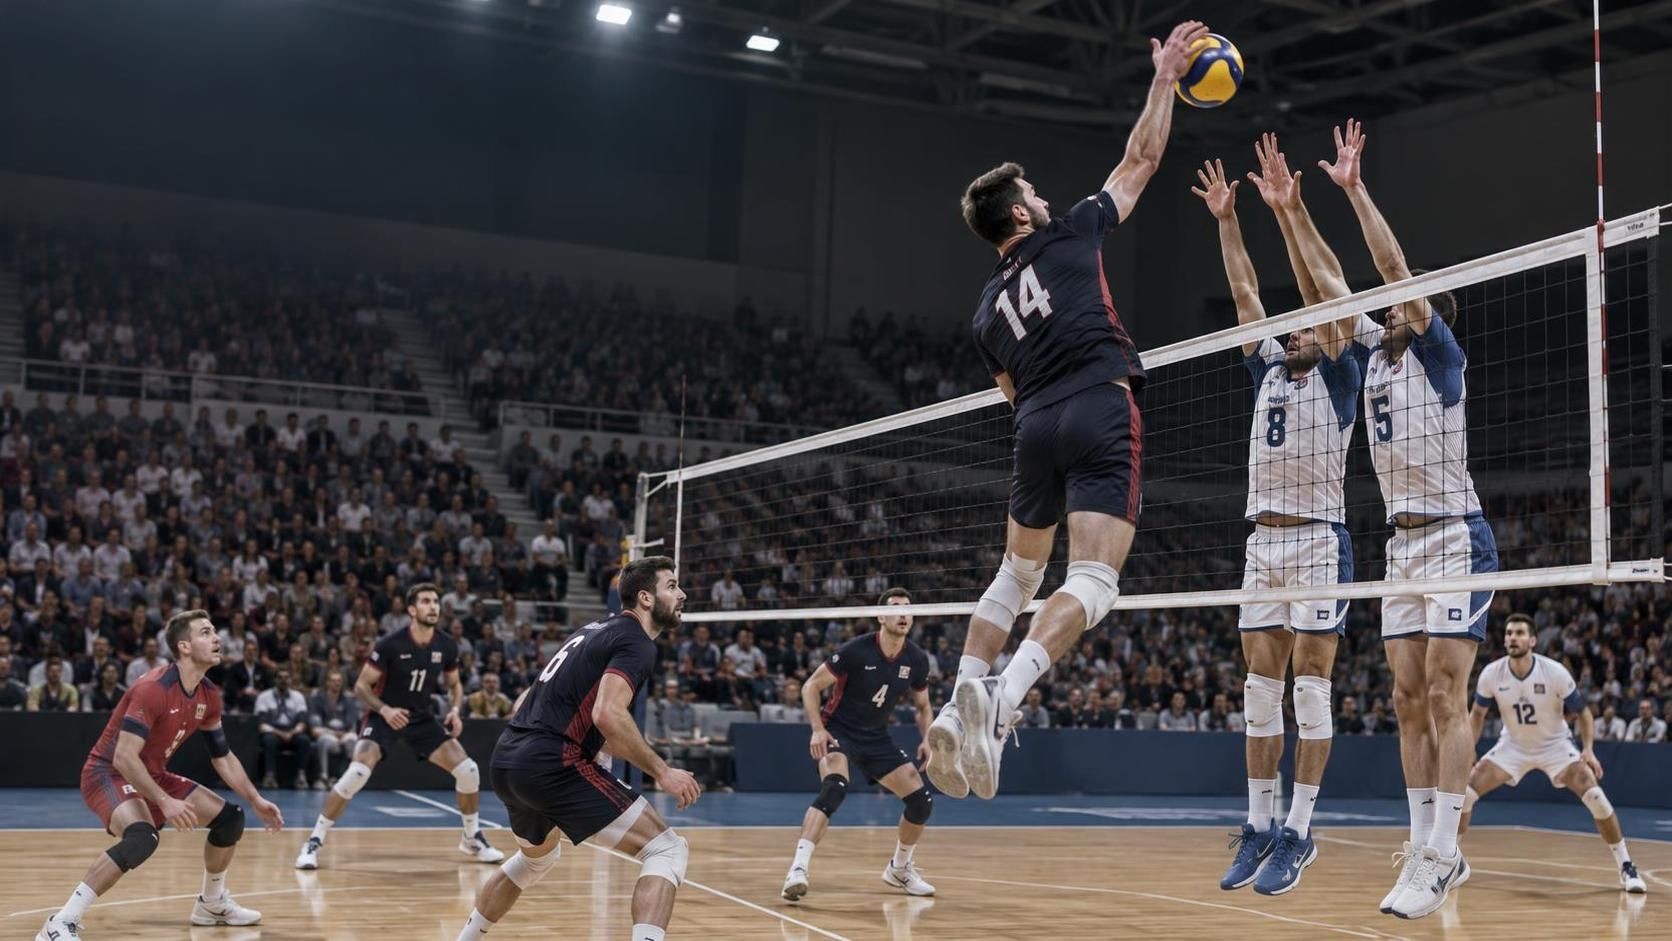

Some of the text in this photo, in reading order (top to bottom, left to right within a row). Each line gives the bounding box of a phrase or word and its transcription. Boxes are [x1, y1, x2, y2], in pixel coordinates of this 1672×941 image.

[995, 264, 1053, 341] 14
[1267, 407, 1286, 447] 8
[1371, 395, 1393, 442] 5
[539, 635, 585, 683] 6
[409, 669, 427, 692] 11
[872, 684, 889, 708] 4
[1513, 704, 1537, 725] 12
